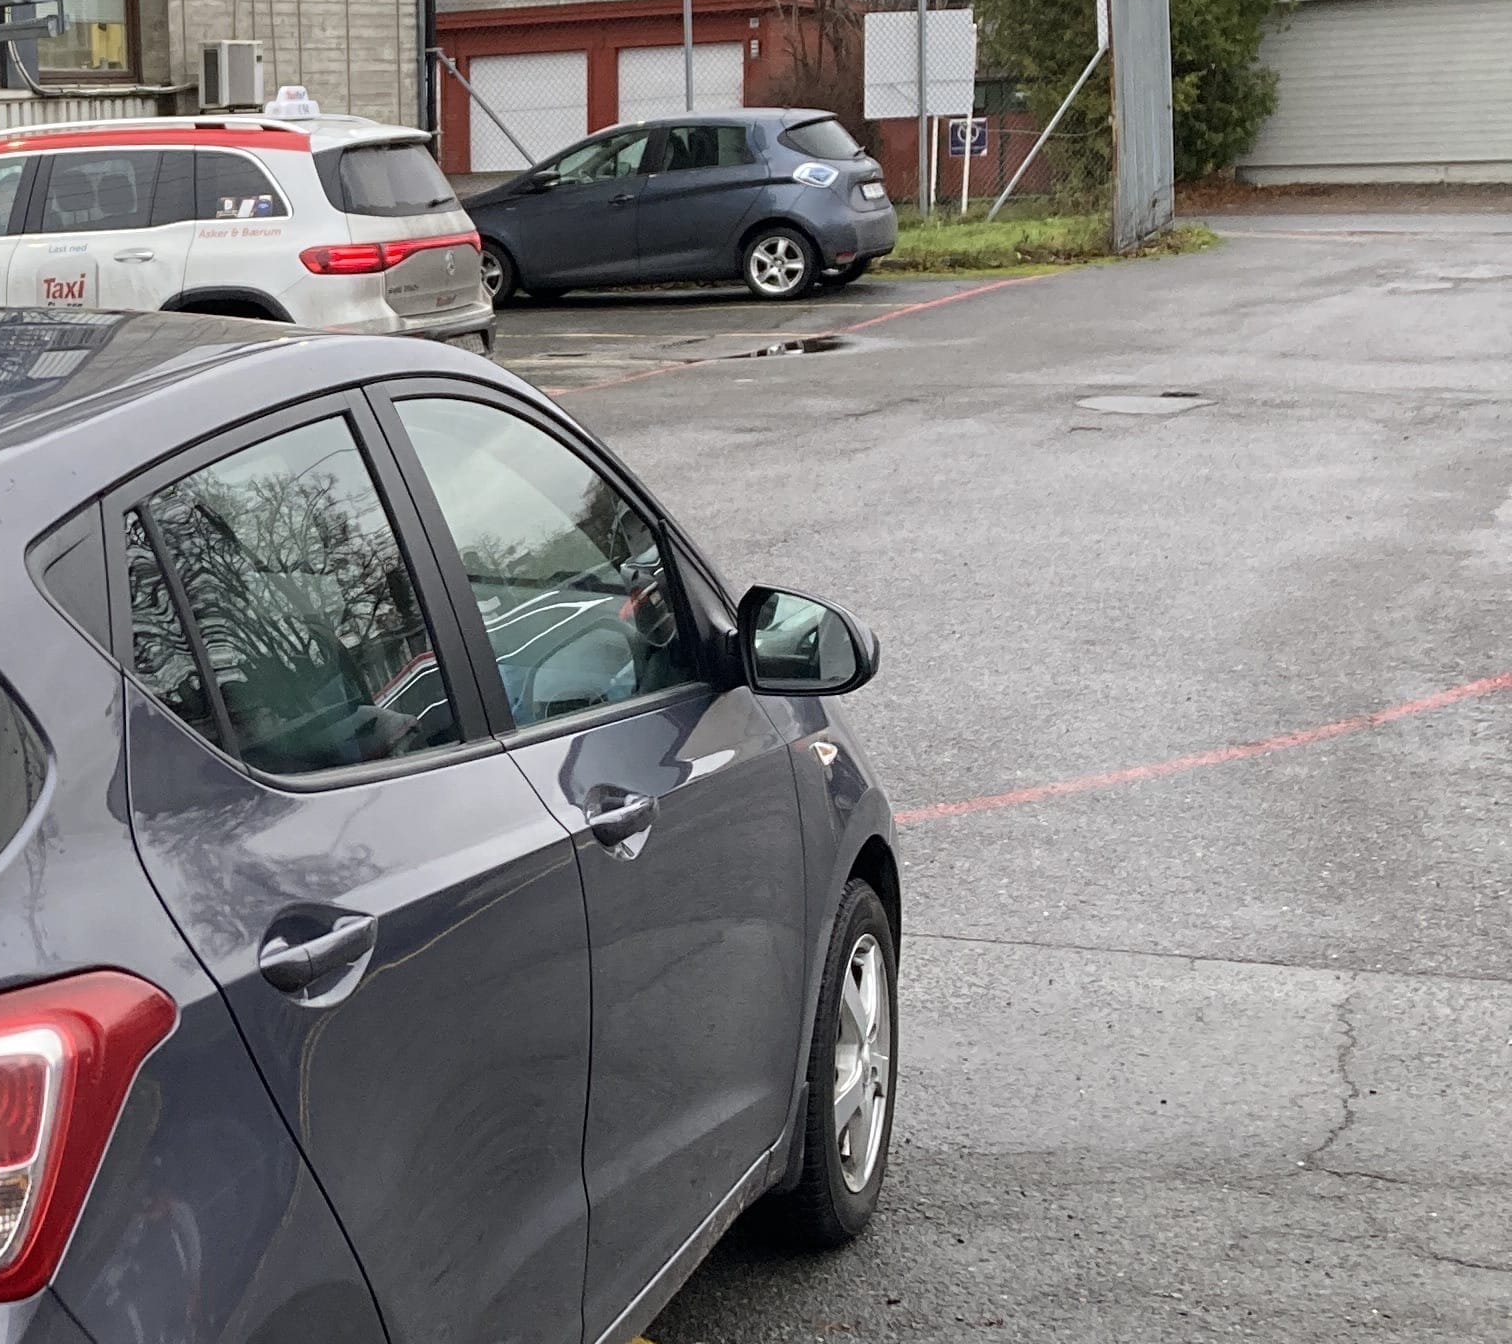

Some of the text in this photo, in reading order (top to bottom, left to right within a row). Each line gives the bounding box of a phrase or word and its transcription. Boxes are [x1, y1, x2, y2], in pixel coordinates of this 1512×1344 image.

[199, 229, 228, 239] Asker
[242, 227, 282, 237] Bærum
[48, 243, 88, 254] Last ned
[43, 273, 86, 299] Taxi
